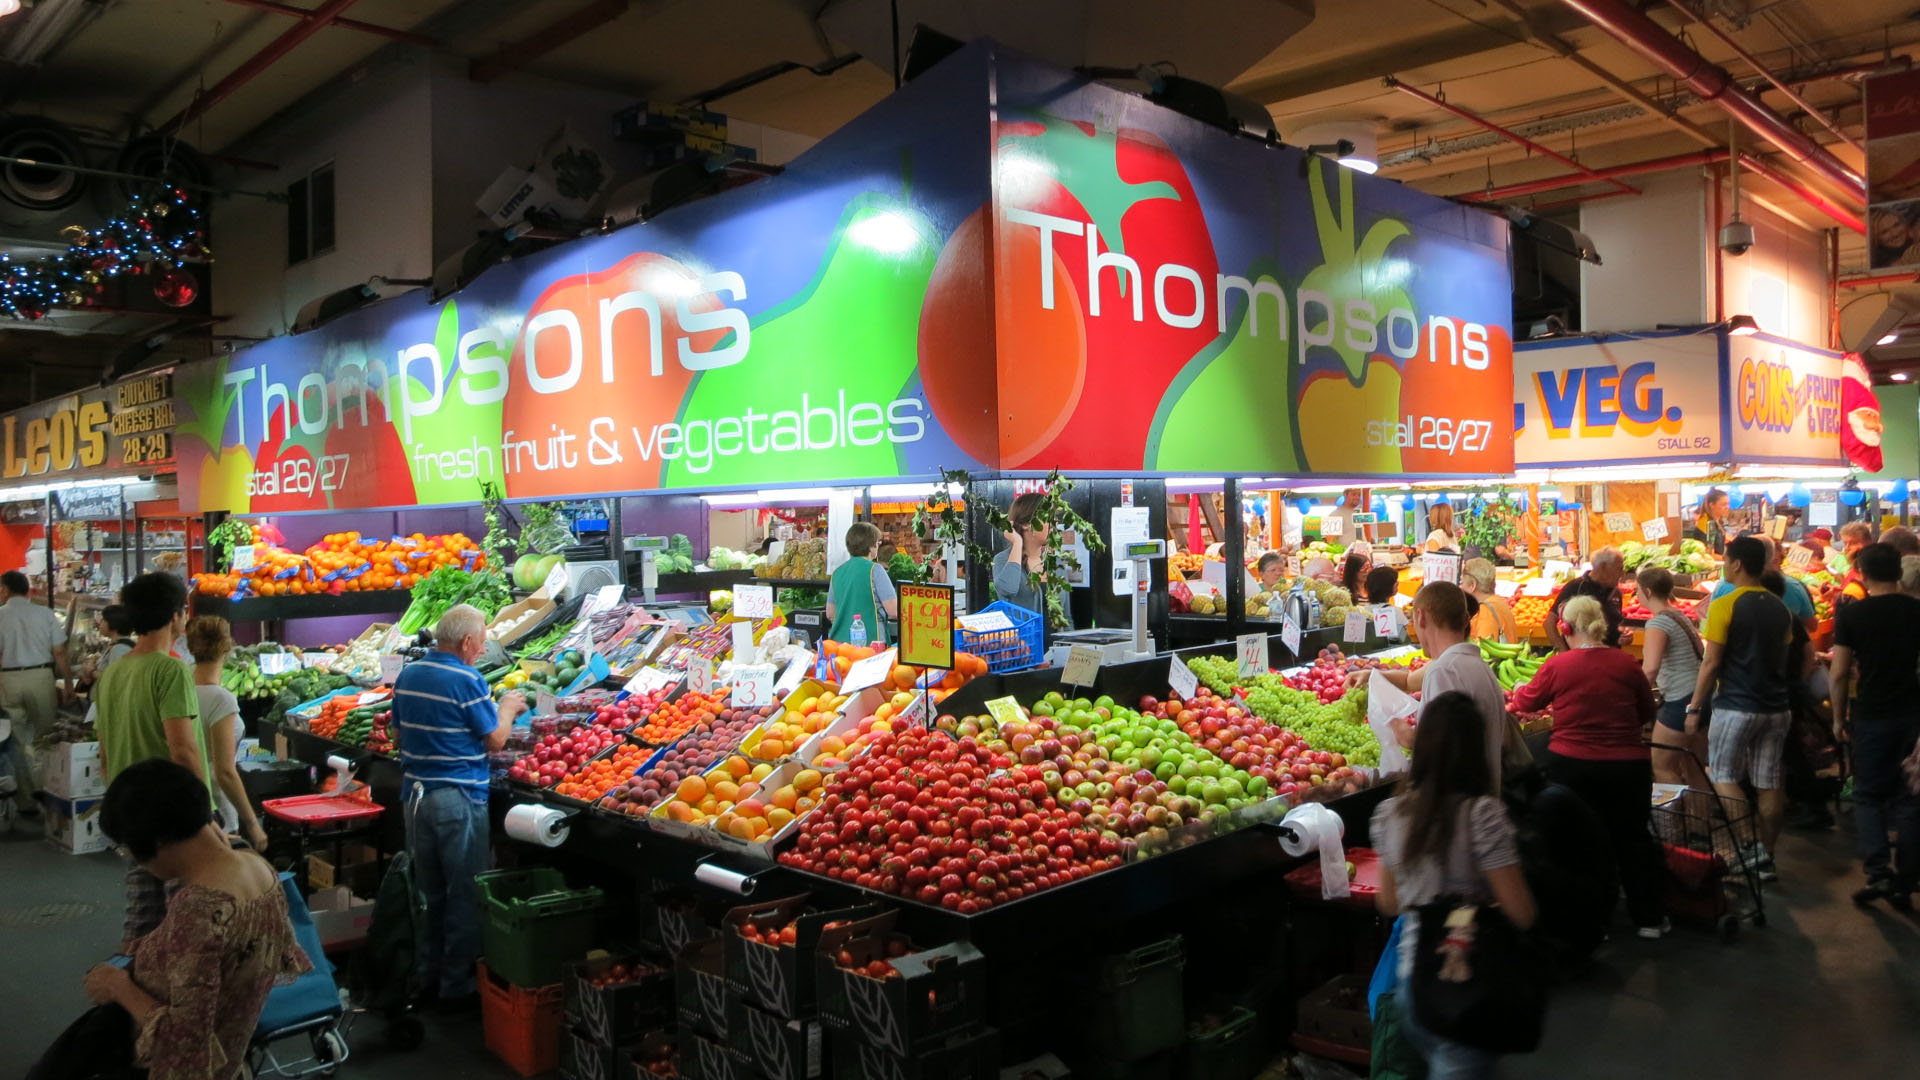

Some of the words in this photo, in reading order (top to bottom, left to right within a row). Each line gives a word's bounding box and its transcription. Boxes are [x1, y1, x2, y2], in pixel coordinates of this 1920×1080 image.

[1005, 208, 1490, 370] Thompsons
[224, 271, 751, 445] Thompsons
[118, 374, 168, 408] GOURMET
[1532, 361, 1683, 437] VEG.
[1807, 373, 1840, 405] FRUIT
[112, 407, 153, 436] CHEESE
[413, 436, 494, 482] fresh
[501, 424, 578, 474] fruit
[588, 417, 623, 466] &
[632, 389, 925, 474] vegetables
[1367, 415, 1414, 448] stall
[1419, 416, 1492, 456] 26/27
[1658, 438, 1691, 450] STALL
[1694, 437, 1711, 448] 52
[245, 462, 279, 496] stall
[283, 454, 350, 498] 26/27
[902, 587, 950, 600] SPECIAL
